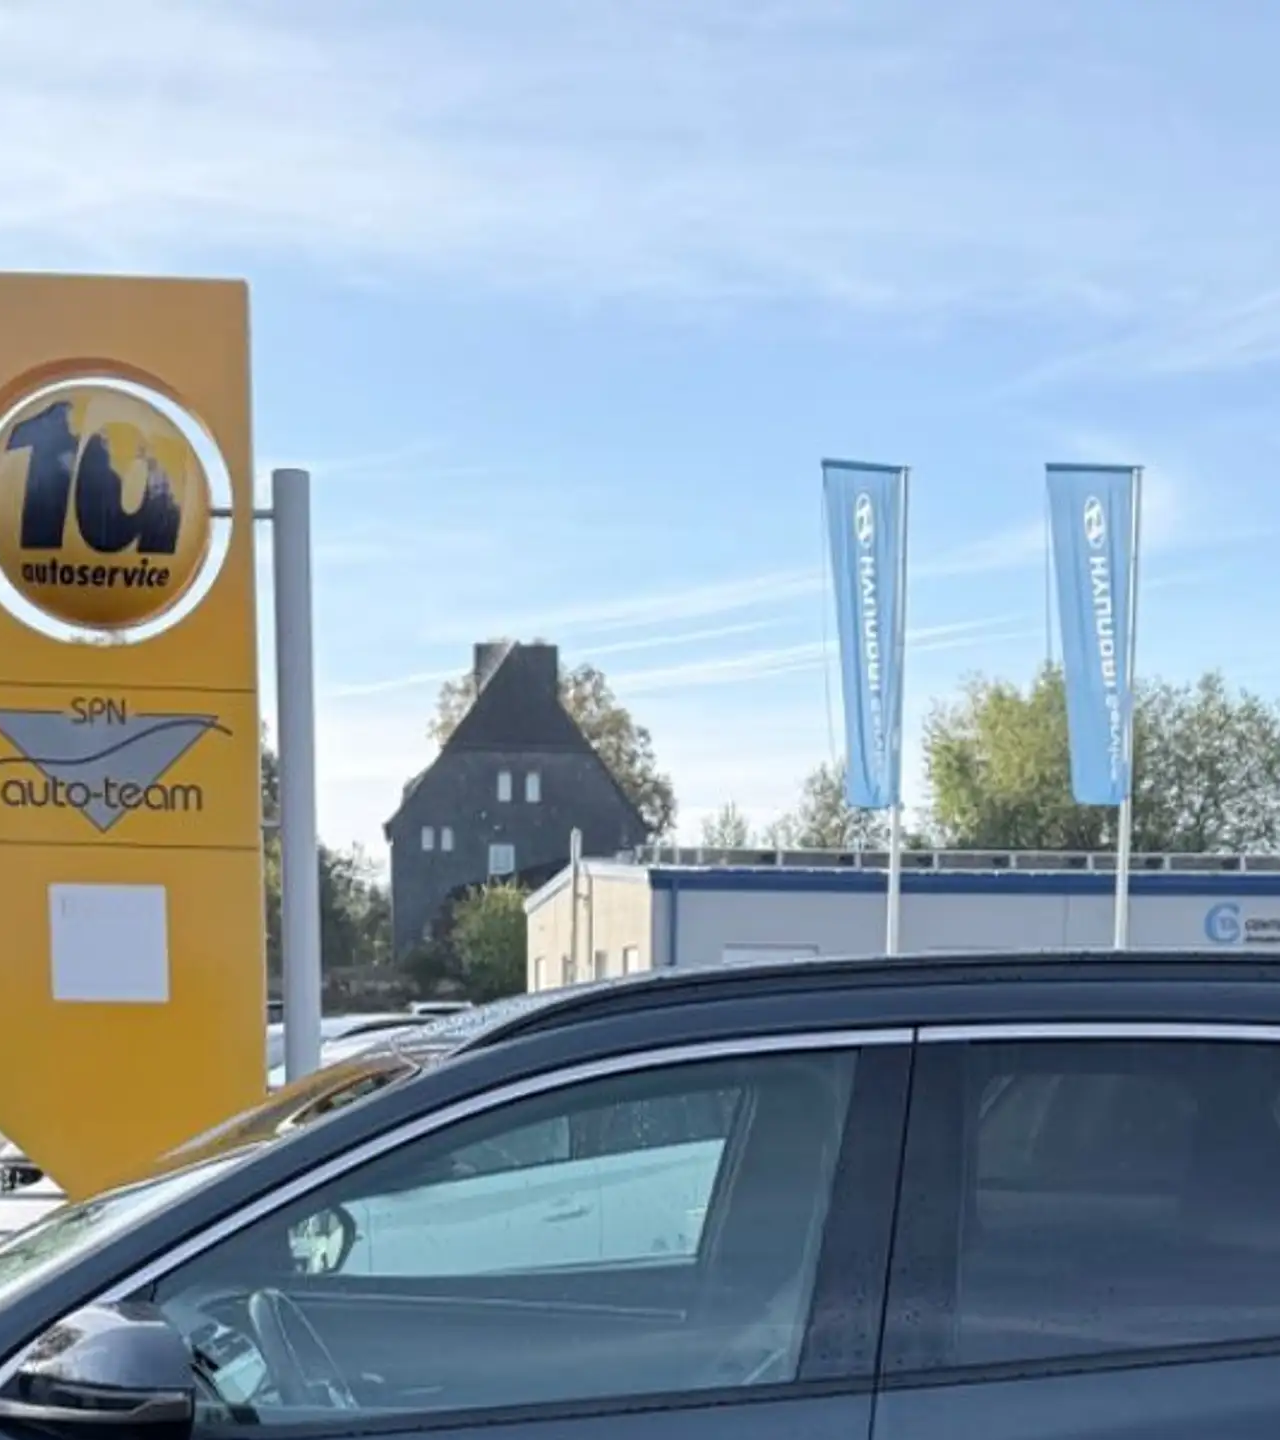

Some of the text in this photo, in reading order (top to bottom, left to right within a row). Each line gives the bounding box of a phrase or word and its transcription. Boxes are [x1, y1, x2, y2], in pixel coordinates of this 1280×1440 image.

[21, 559, 171, 588] autoservice
[71, 696, 127, 726] SPN
[0, 776, 204, 813] auto-team
